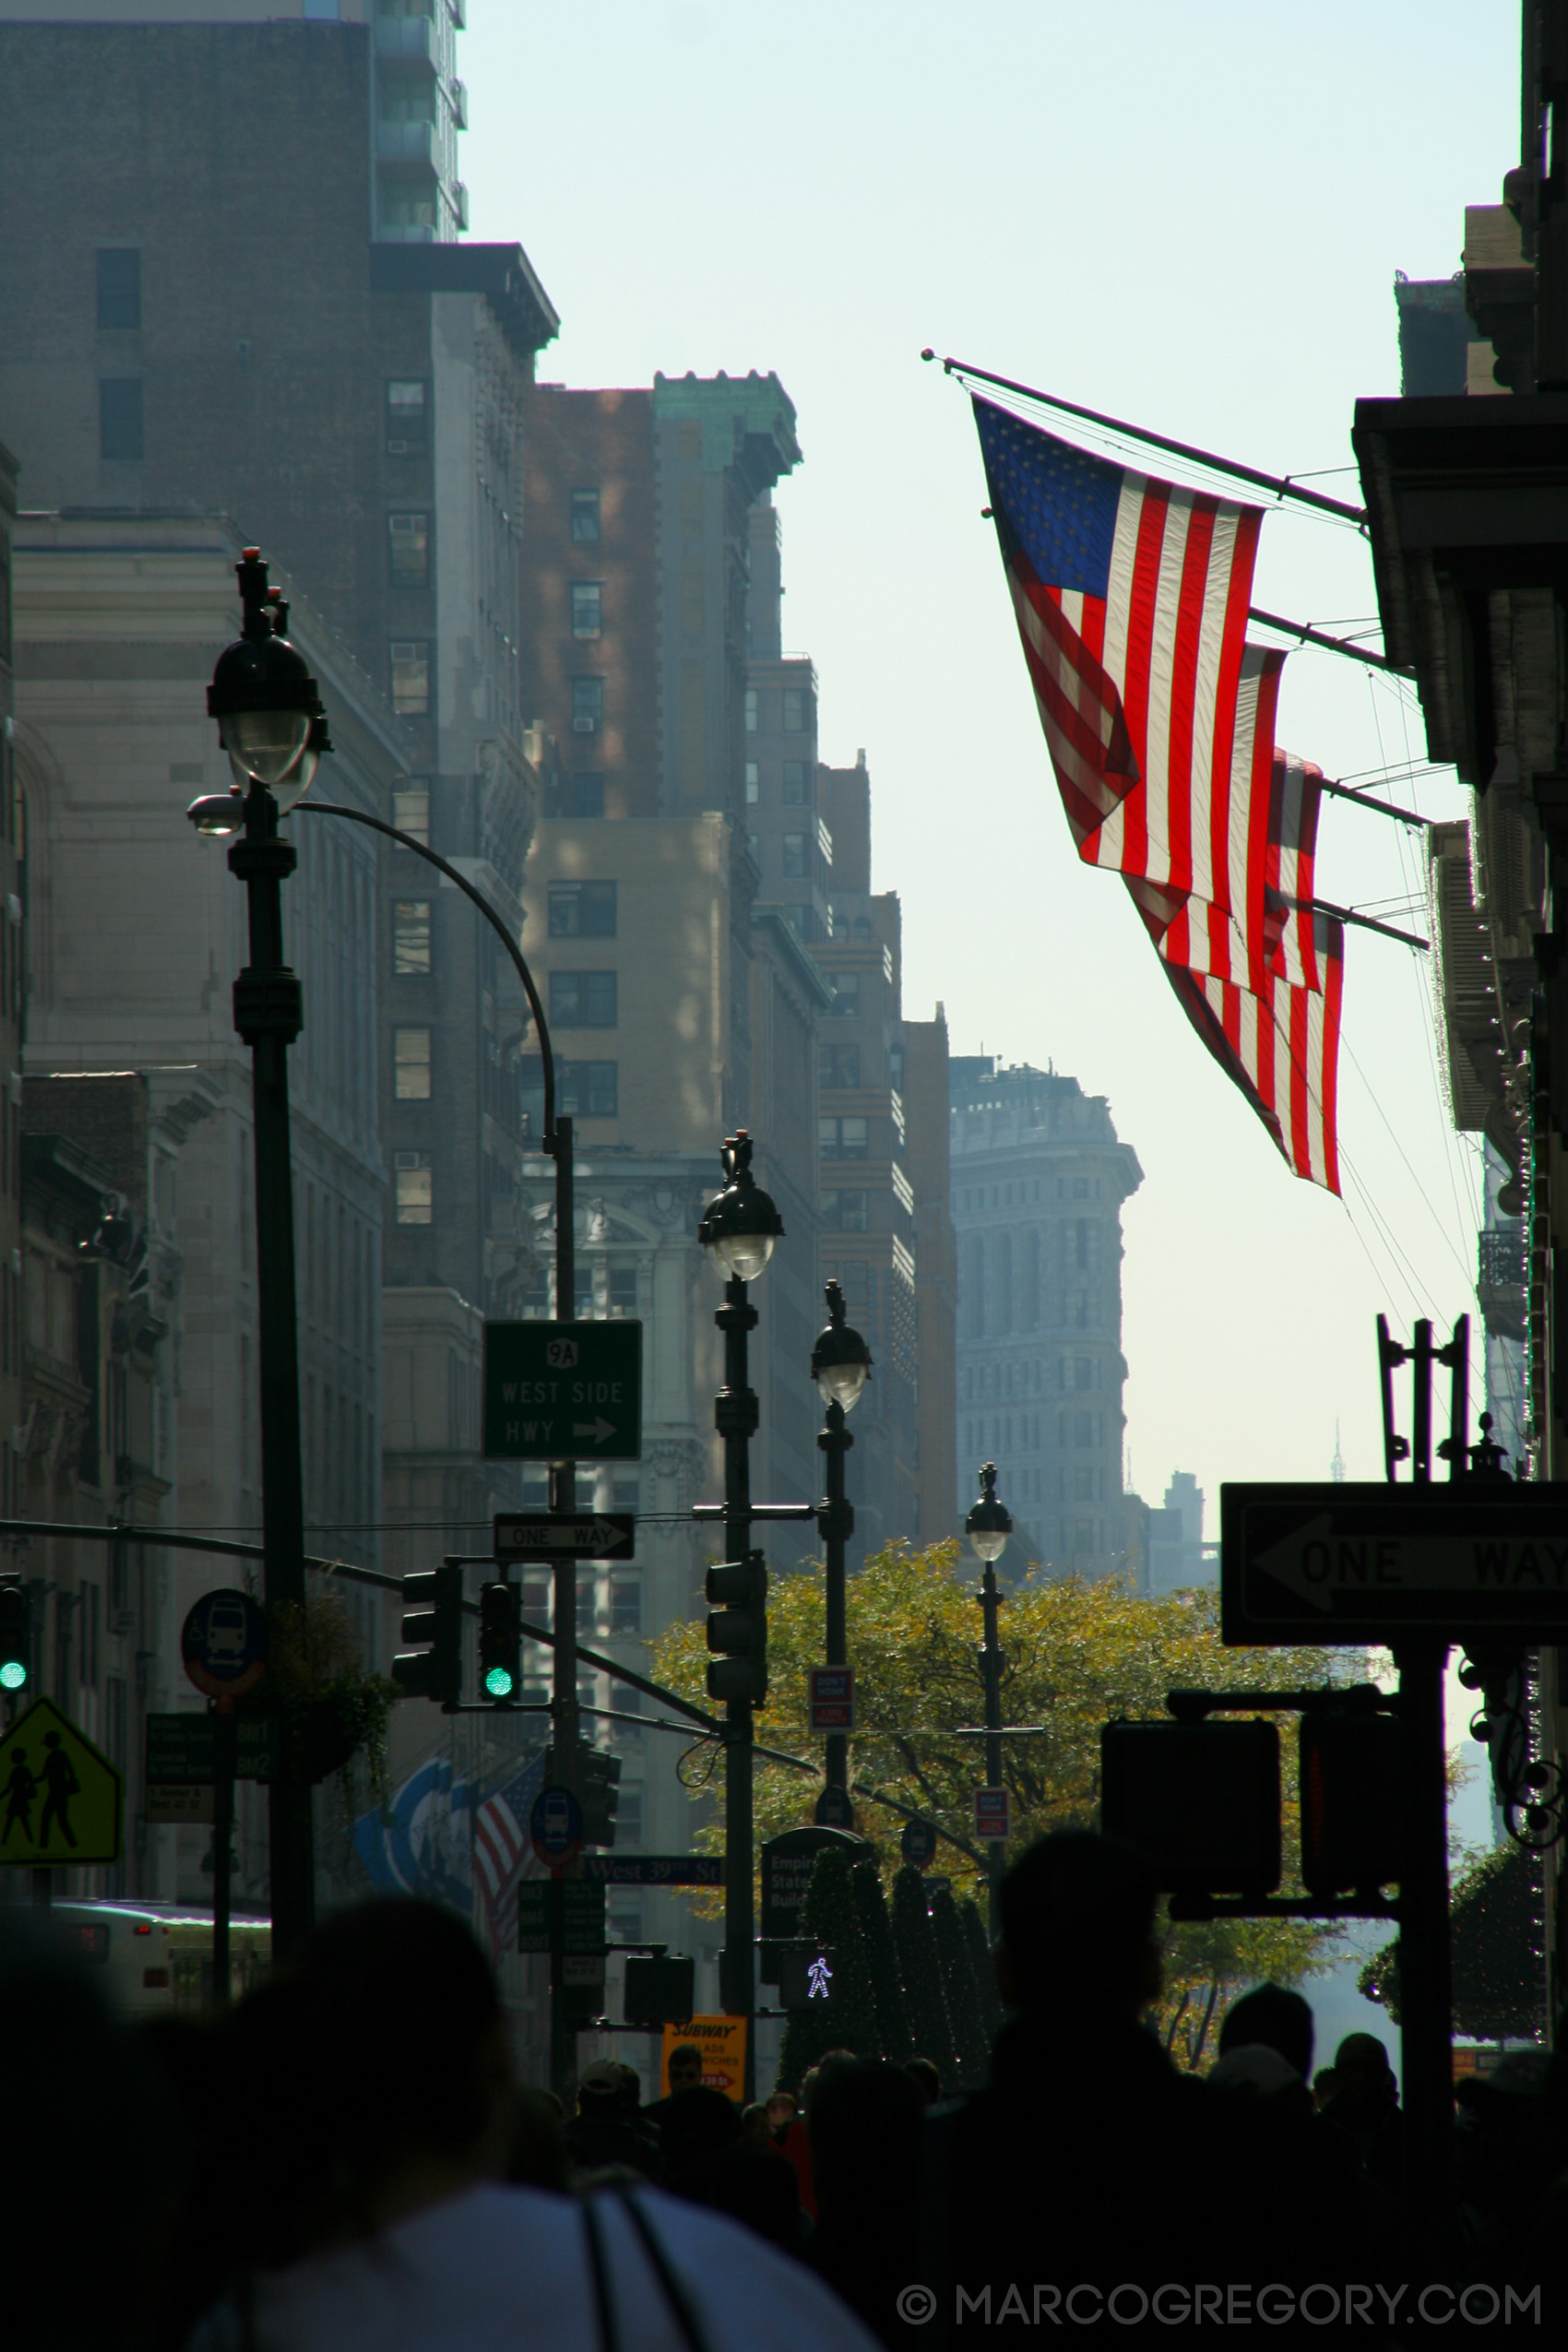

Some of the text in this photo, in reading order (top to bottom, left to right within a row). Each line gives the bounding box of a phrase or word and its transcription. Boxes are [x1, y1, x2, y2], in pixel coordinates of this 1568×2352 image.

[550, 1343, 575, 1364] 9A
[502, 1382, 624, 1404] WEST SIDE
[505, 1420, 554, 1443] HWY
[513, 1527, 613, 1545] ONE WAY
[1301, 1540, 1568, 1585] ONE WAY
[237, 1721, 268, 1743] BM1
[236, 1752, 272, 1776] BM2
[589, 1859, 643, 1881] West
[695, 1860, 719, 1882] St
[771, 1855, 813, 1873] Empir
[671, 2022, 738, 2039] SUBWAY
